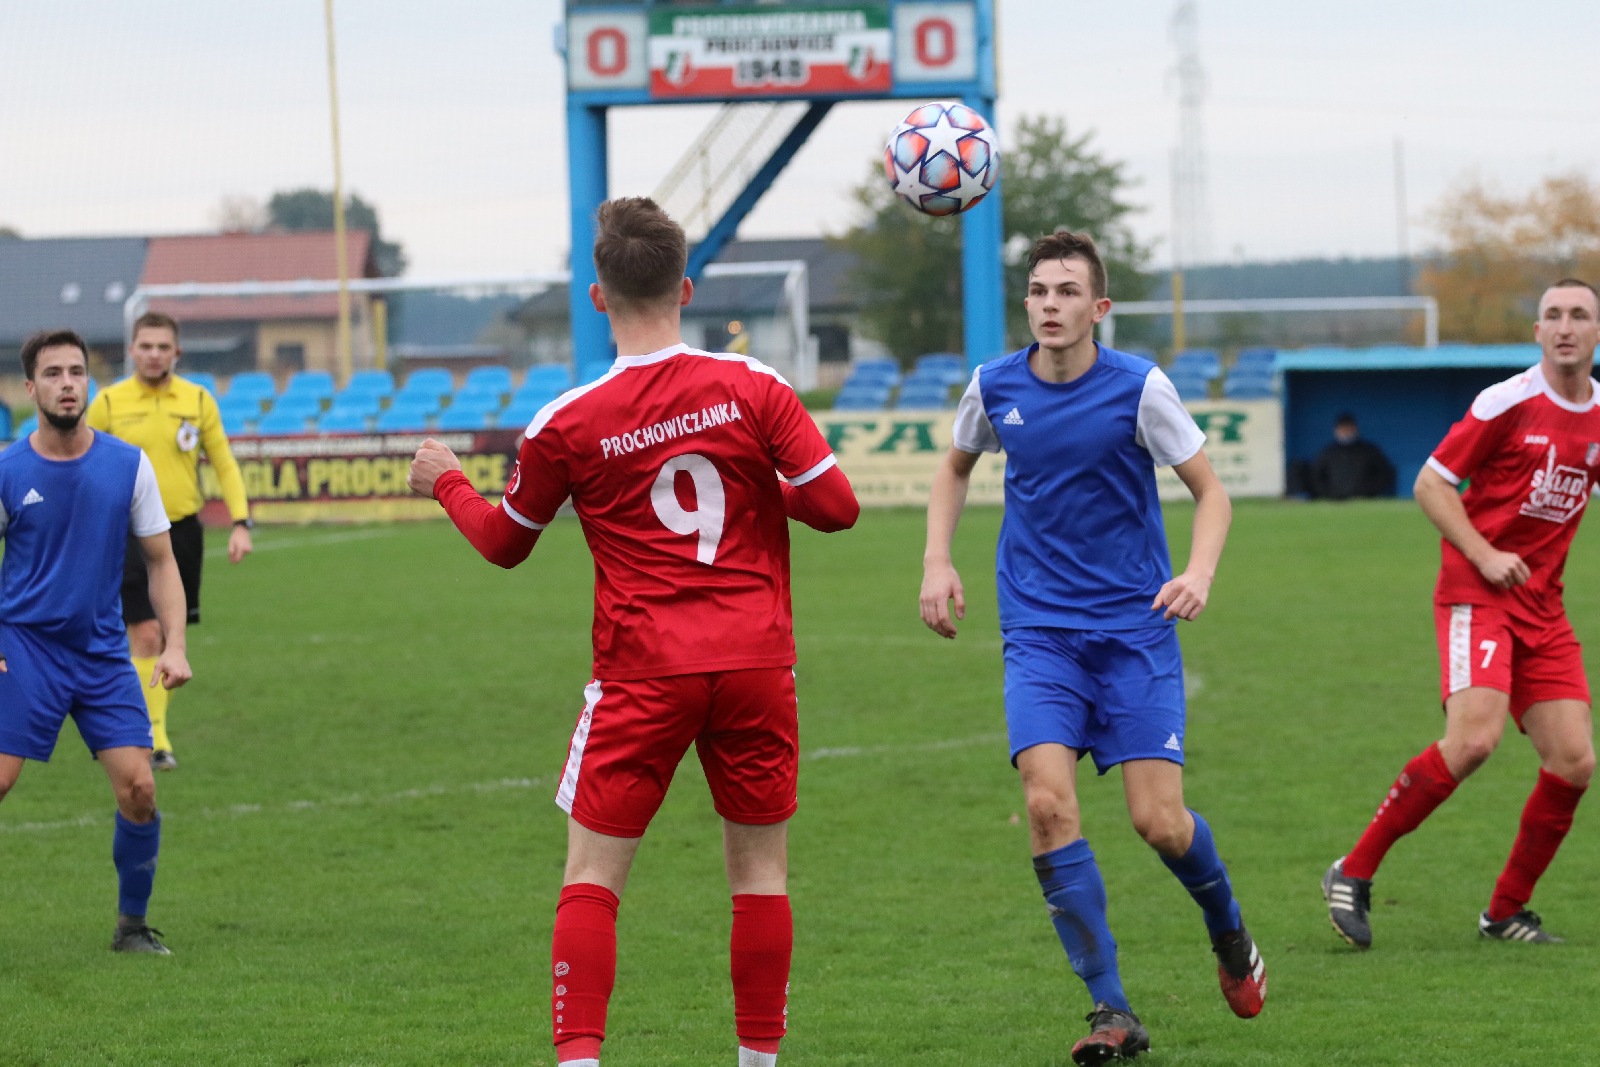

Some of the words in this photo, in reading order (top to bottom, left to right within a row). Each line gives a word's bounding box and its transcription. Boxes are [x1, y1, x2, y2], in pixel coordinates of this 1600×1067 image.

[587, 27, 627, 77] 0
[915, 17, 955, 68] 0
[600, 400, 742, 460] PROCHOWICZANKA
[651, 453, 725, 565] 9
[1479, 639, 1498, 669] 7
